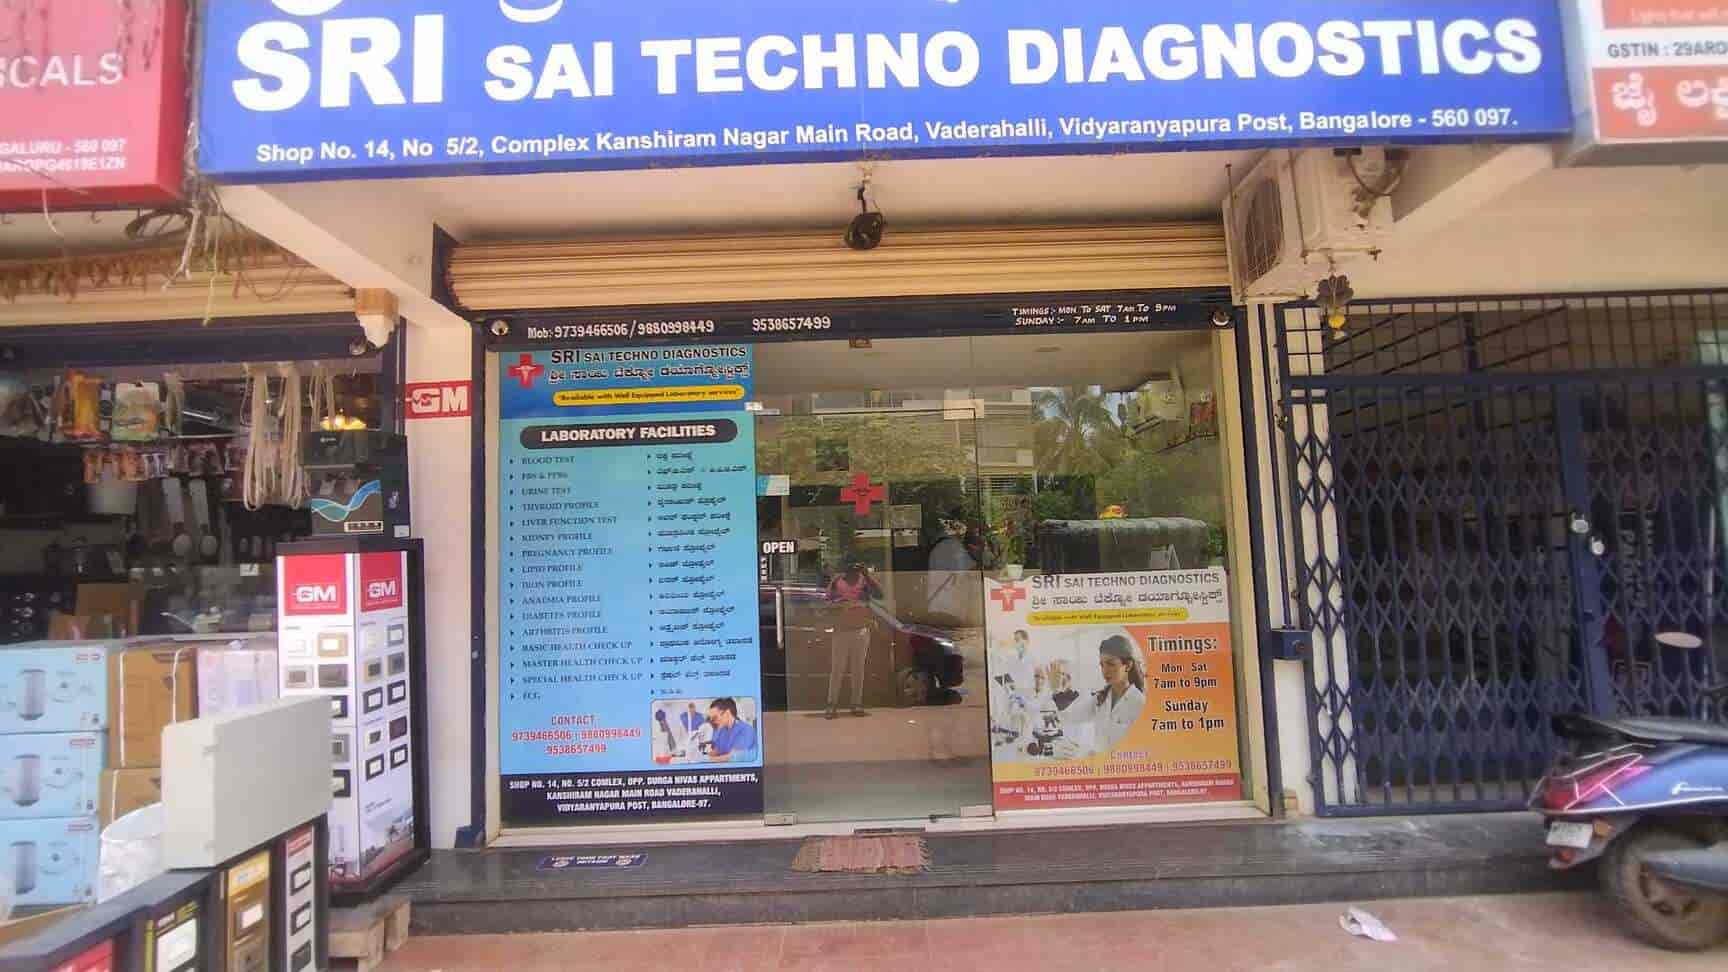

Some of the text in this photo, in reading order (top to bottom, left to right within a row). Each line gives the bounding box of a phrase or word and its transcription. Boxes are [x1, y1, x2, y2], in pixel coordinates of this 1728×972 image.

[1607, 42, 1659, 58] GSTIN
[0, 52, 124, 88] CALS
[231, 14, 1543, 112] SRI SAI TECHNO DIAGNOSTICS
[257, 143, 314, 165] Shop
[320, 142, 357, 160] No.
[364, 140, 395, 161] 14,
[402, 139, 434, 158] No
[446, 137, 484, 159] 5/2,
[491, 133, 590, 157] Complex
[597, 129, 716, 151] Kanshiram
[723, 127, 789, 151] Nagar
[796, 124, 849, 144] Main
[856, 122, 919, 145] Road,
[926, 117, 1053, 140] Vaderahalli,
[1059, 113, 1231, 138] Vidyaranyapura
[1237, 112, 1293, 134] Post,
[1300, 110, 1413, 134] Bangalore
[1432, 109, 1469, 127] 560
[1475, 107, 1518, 127] 097.
[1095, 304, 1111, 313] SAT
[751, 316, 832, 332] 9538657499
[551, 347, 746, 364] SRI SAI TECHNO DIAGNOSTICS
[541, 424, 716, 443] LABORATORY FACILITIES
[762, 541, 795, 554] OPEN
[1031, 572, 1220, 589] SRI SAI TECHNO DIAGNOSTICS
[1147, 635, 1217, 654] Timings:
[1161, 662, 1208, 673] Mon Sat
[1153, 676, 1217, 689] 7am to 9pm
[1165, 699, 1209, 713] Sunday
[1151, 717, 1225, 731] 7am to 1pm
